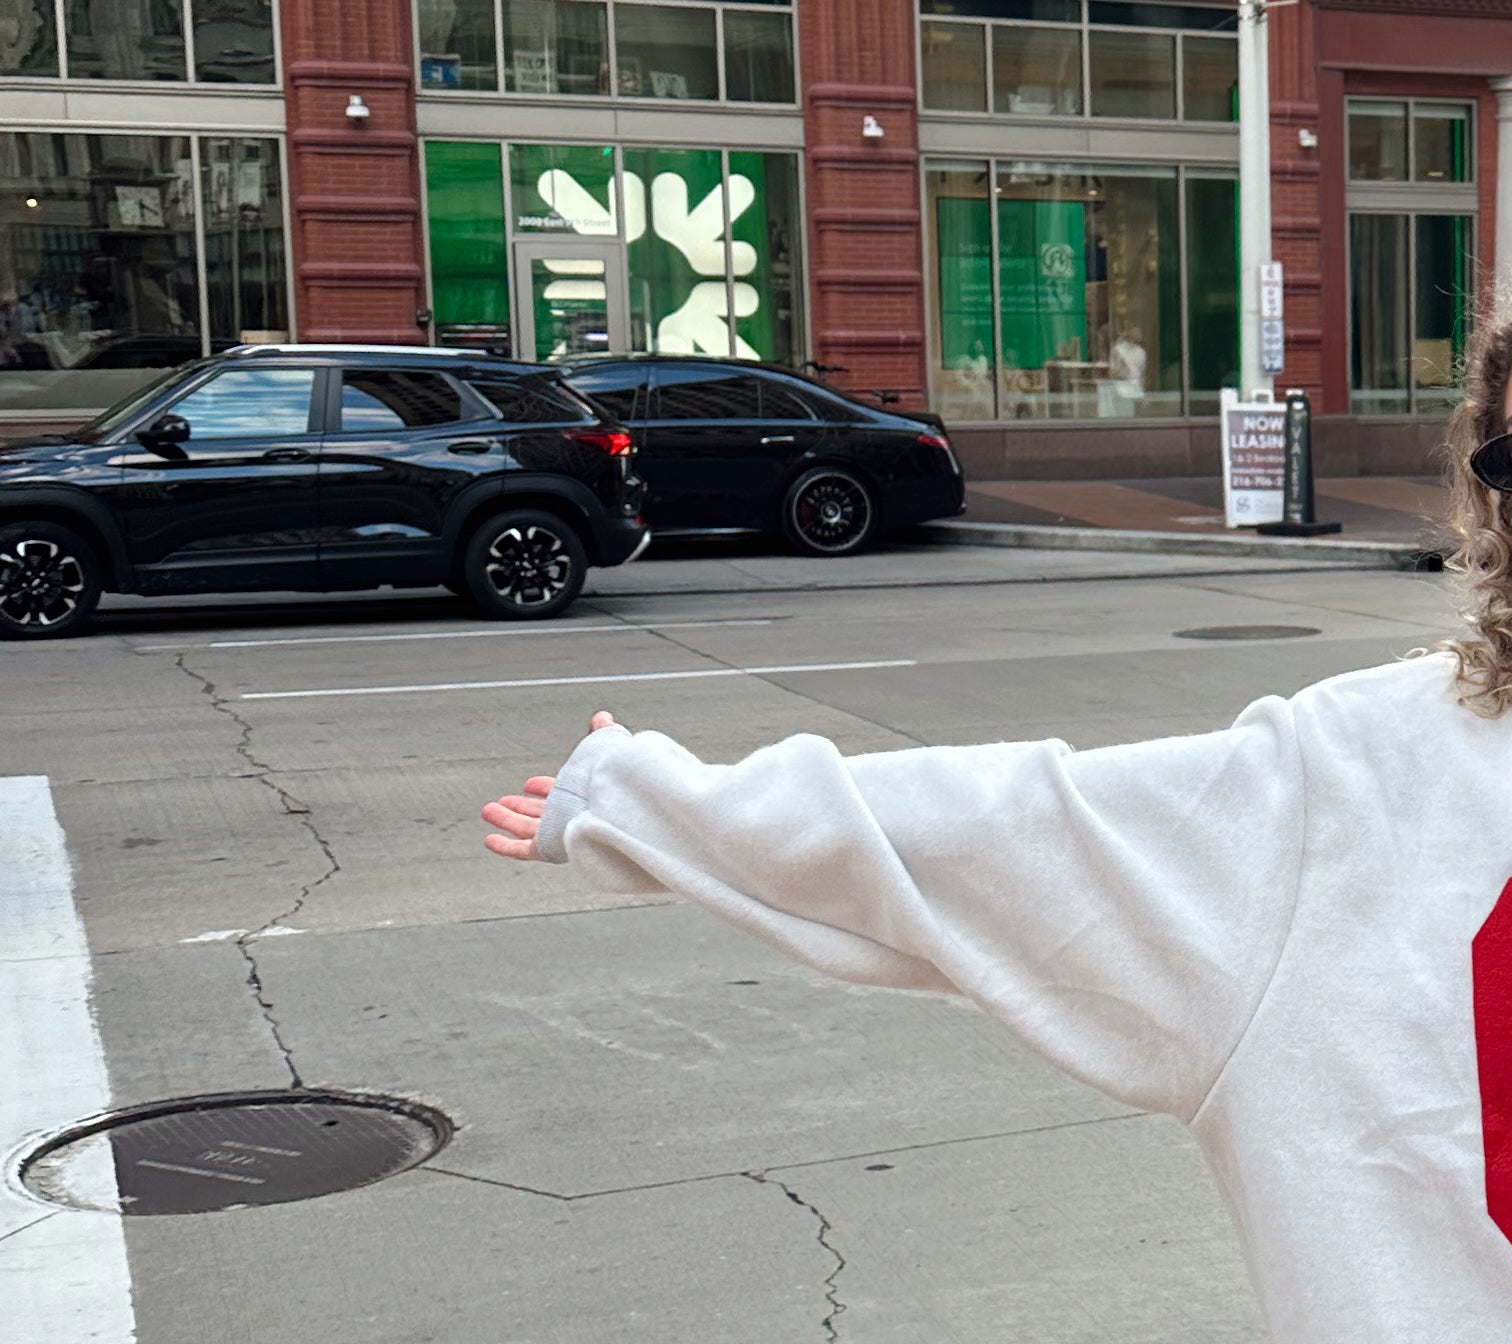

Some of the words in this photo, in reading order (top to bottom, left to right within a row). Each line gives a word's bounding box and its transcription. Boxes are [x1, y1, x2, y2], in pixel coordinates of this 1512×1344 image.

[1243, 416, 1284, 431] NOW
[1231, 434, 1285, 448] LEASIN
[1290, 425, 1303, 499] VALET
